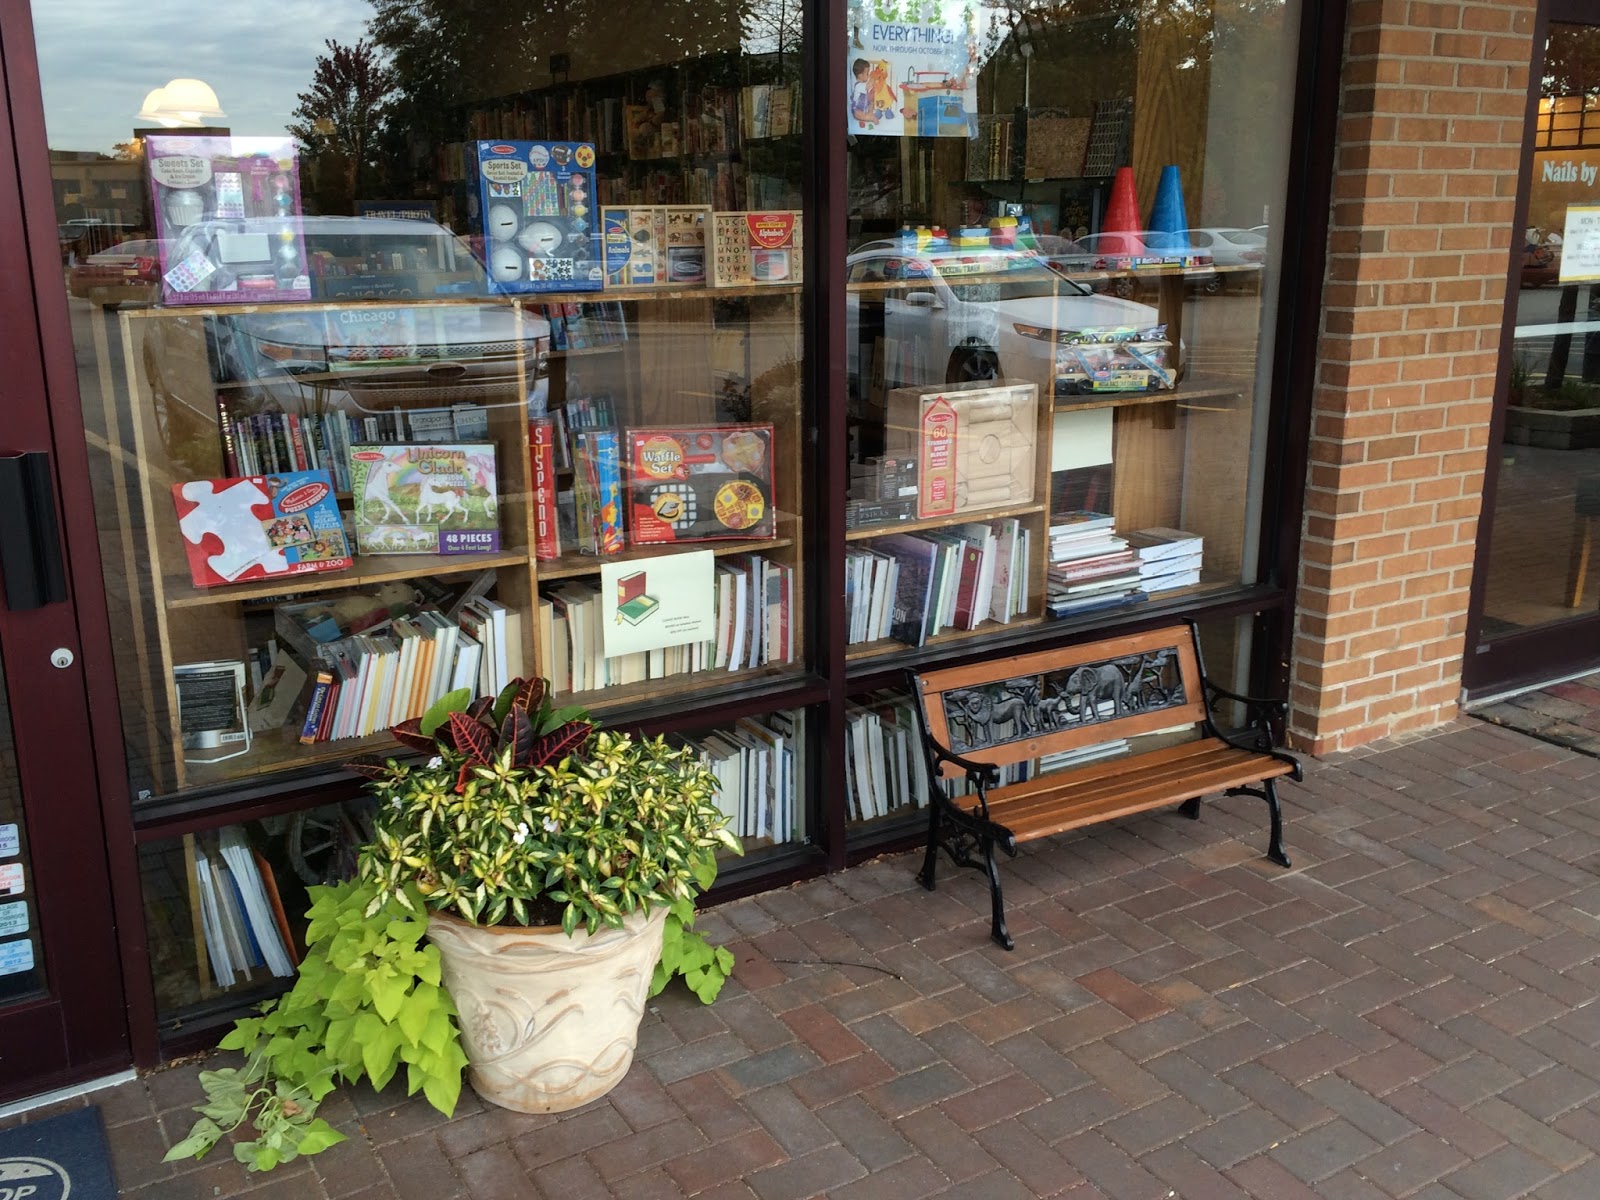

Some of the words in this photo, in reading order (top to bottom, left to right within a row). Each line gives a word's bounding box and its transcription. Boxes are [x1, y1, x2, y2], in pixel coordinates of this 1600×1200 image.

[872, 24, 954, 44] EVERYTHING!
[889, 45, 918, 53] THROUGH
[158, 159, 189, 168] Sweets
[190, 159, 204, 168] Set
[488, 162, 509, 170] Sports
[1541, 160, 1578, 182] Nails
[1580, 161, 1598, 187] by
[758, 228, 784, 239] Alphabet
[340, 310, 396, 325] Chicago
[933, 427, 946, 438] 60
[405, 446, 466, 463] Unicorn
[643, 451, 681, 462] Waffle
[418, 460, 463, 475] Glade
[651, 462, 673, 474] Set
[446, 535, 458, 543] 48
[460, 534, 492, 543] PIECES
[297, 561, 318, 571] FARM
[326, 559, 344, 568] ZOO
